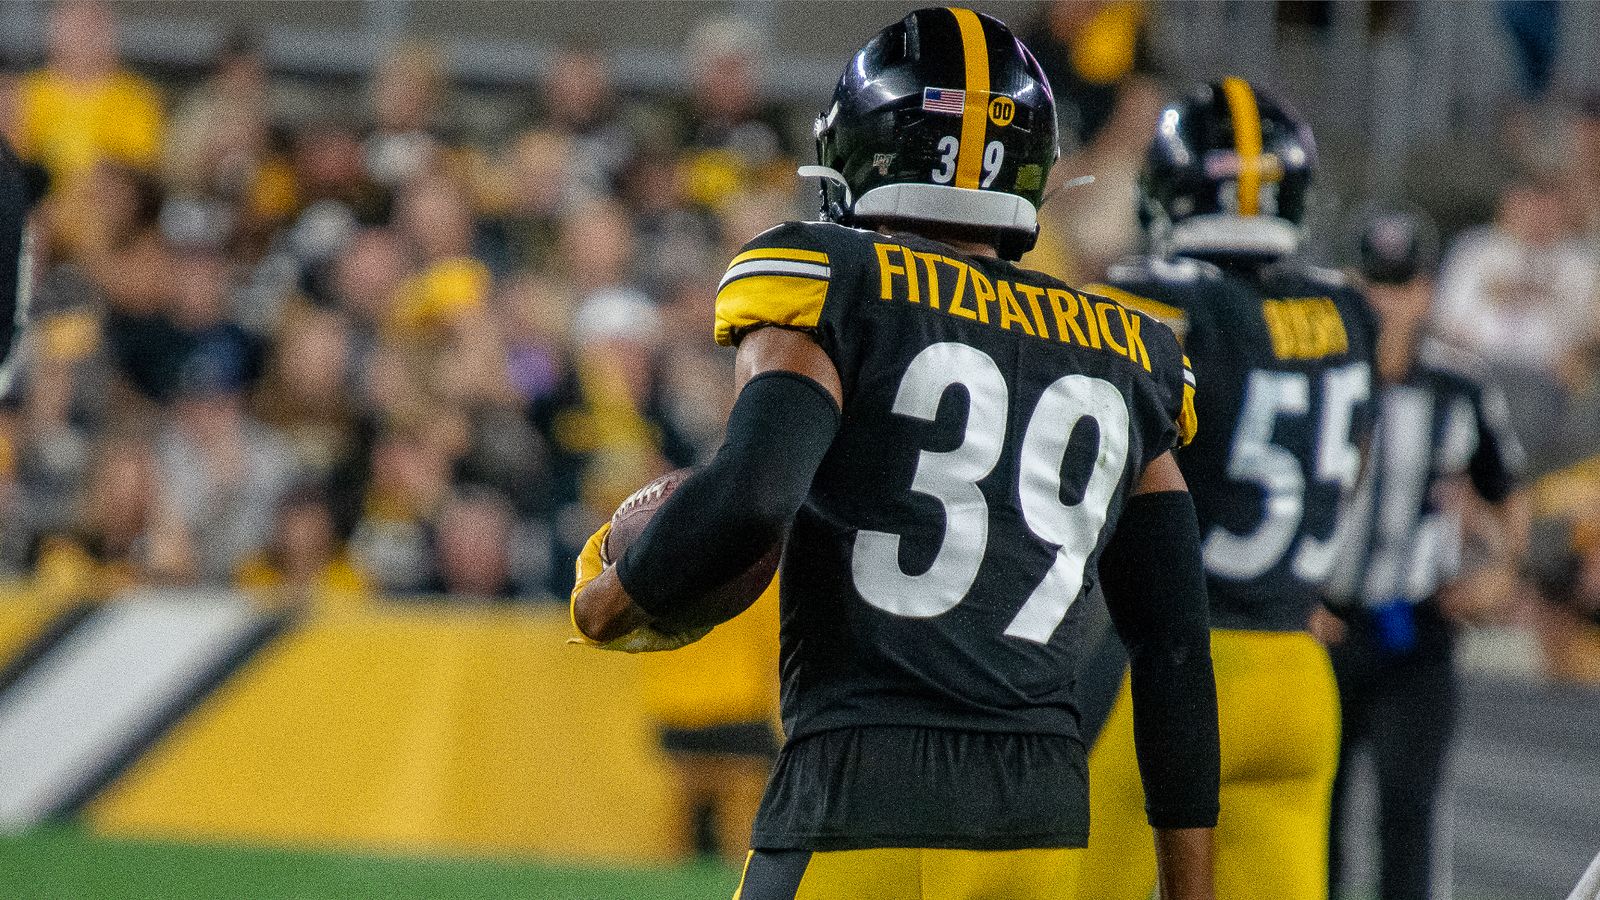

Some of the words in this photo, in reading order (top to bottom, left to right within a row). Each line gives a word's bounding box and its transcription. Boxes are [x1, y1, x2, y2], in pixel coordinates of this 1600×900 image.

[874, 242, 1152, 373] FITZPATRICK
[851, 341, 1130, 645] 39
[1202, 361, 1372, 581] 55
